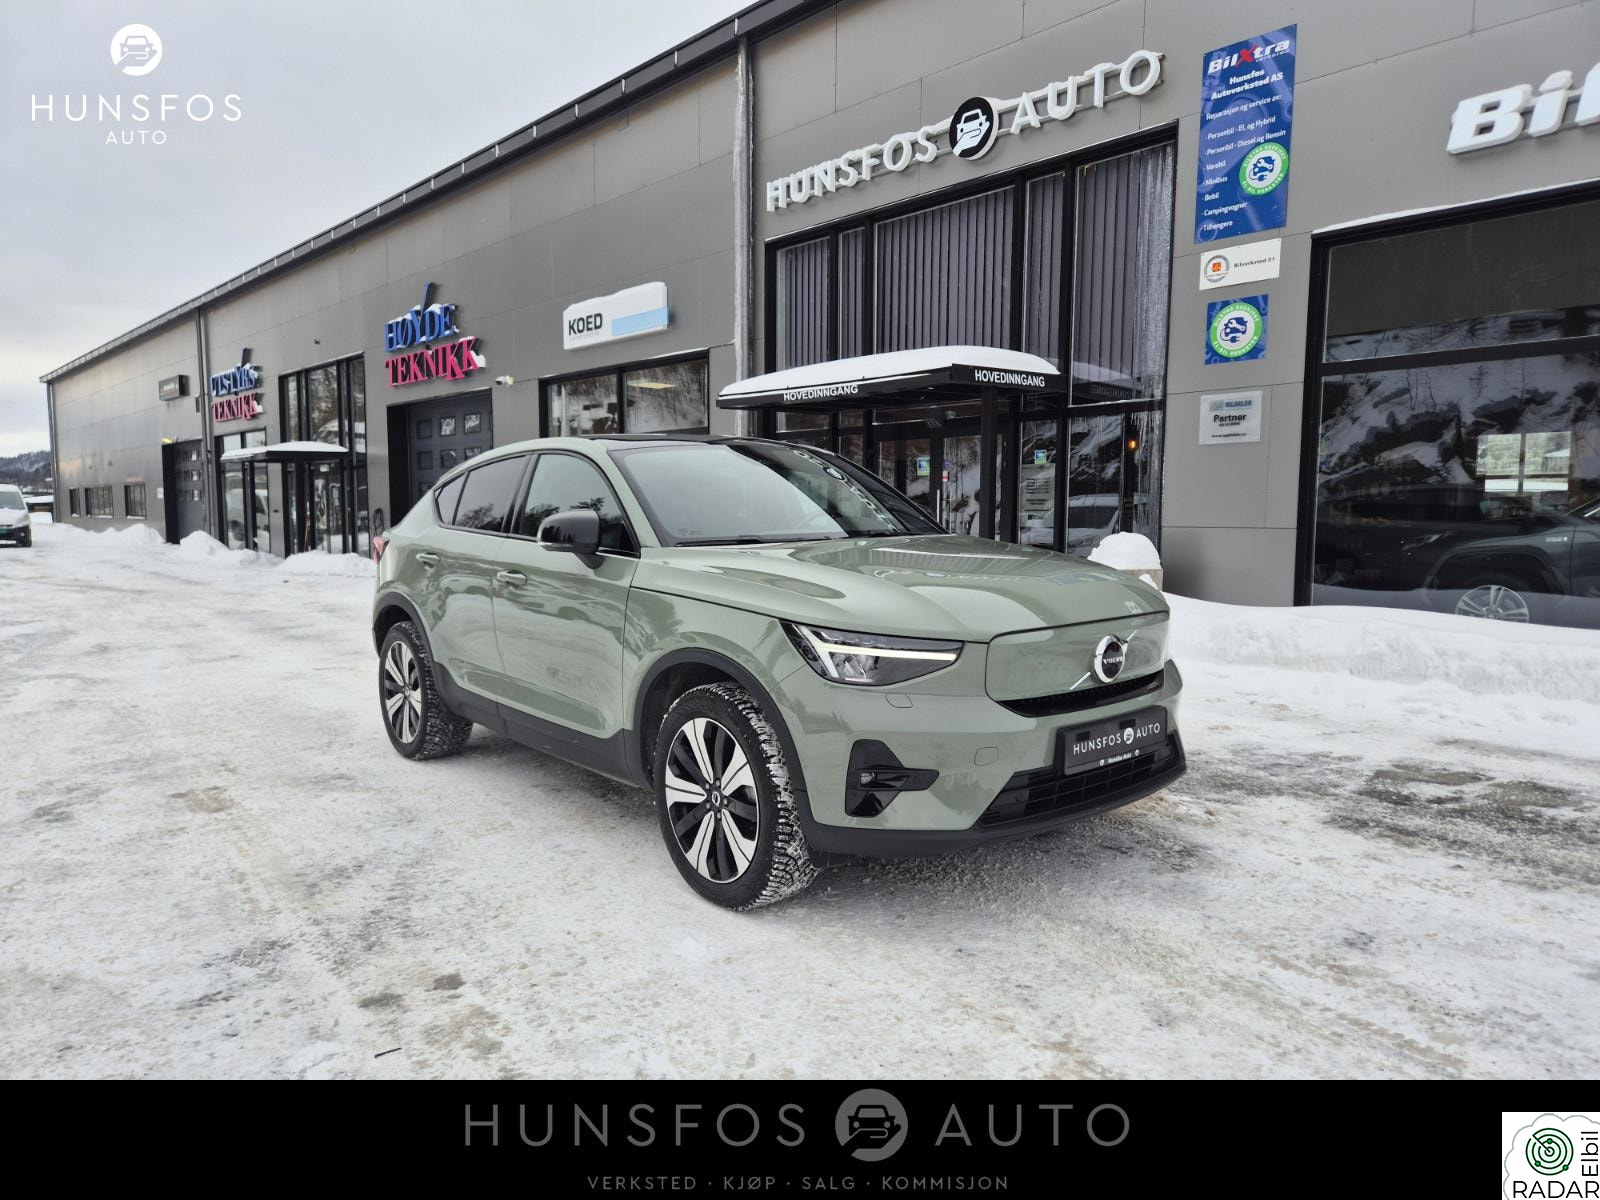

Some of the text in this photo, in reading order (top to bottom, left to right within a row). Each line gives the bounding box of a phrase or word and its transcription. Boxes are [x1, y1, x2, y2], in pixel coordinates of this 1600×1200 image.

[1208, 40, 1290, 74] BilXtra
[1211, 72, 1284, 100] Autoverksted AS
[1229, 69, 1265, 85] Hunsfos
[1206, 106, 1240, 121] Reparasjon
[1239, 103, 1248, 112] og
[1248, 97, 1271, 110] service
[766, 50, 1161, 211] HUNSFOS AUTO
[1207, 127, 1235, 140] Personbil
[1247, 121, 1255, 130] og
[1255, 115, 1276, 129] Hybrid
[1206, 142, 1234, 156] Personbil
[1237, 137, 1256, 147] Diesel
[1265, 129, 1287, 140] Bensin
[1206, 160, 1226, 171] Varebil
[1203, 202, 1248, 216] Campingvogner
[384, 282, 456, 352] HØYDE
[568, 312, 603, 336] KOED
[384, 335, 480, 388] TEKNIKK
[975, 369, 1046, 387] HOVEDINNGANG
[783, 384, 859, 401] HOVEDINNGANG
[211, 391, 258, 422] TEKNIKK
[1213, 414, 1247, 423] Partner
[1073, 722, 1161, 755] HUNSFOS AUTO
